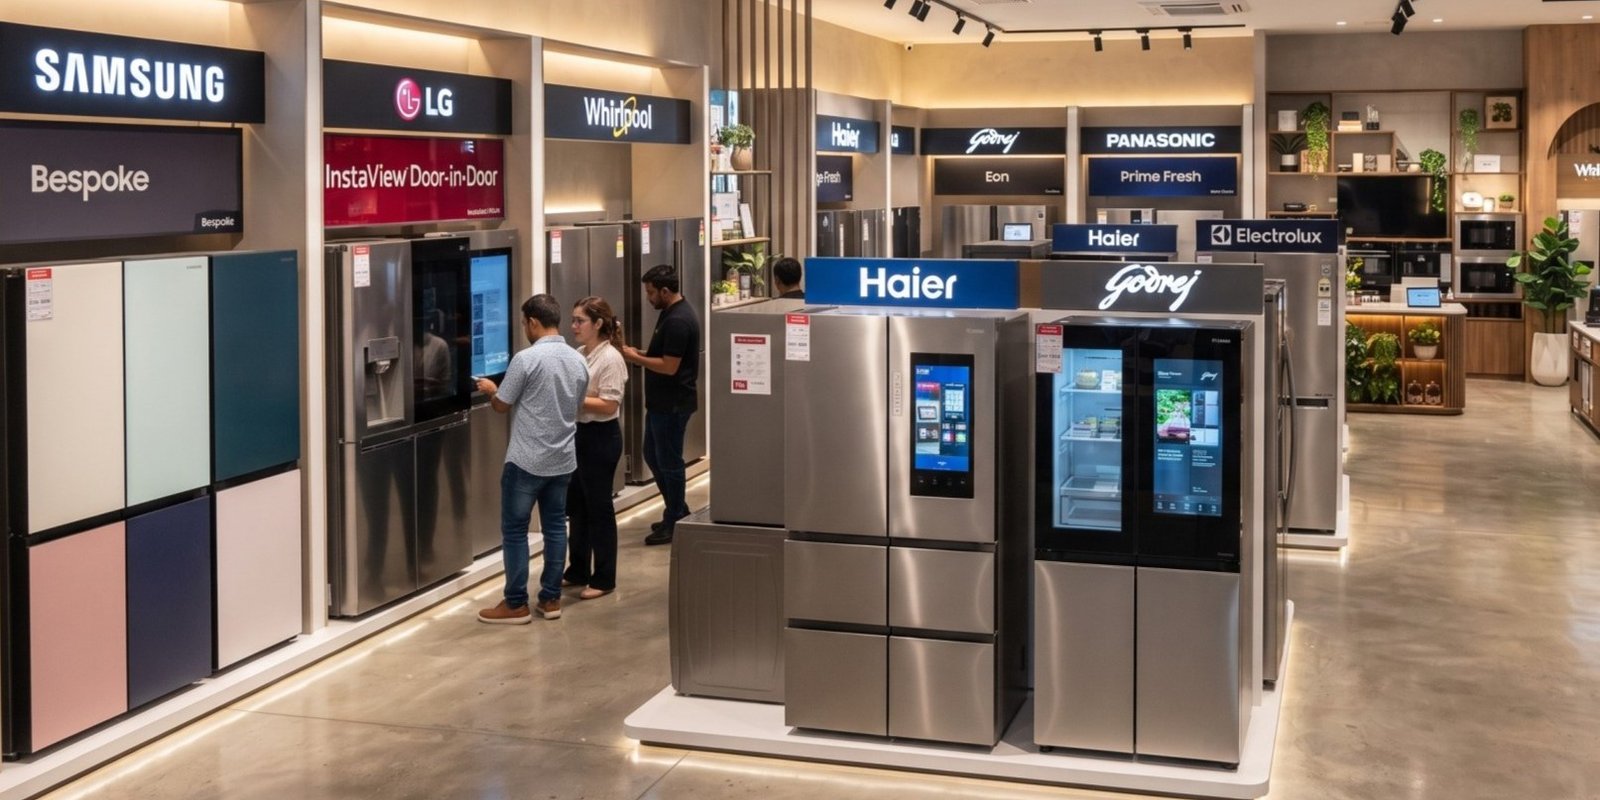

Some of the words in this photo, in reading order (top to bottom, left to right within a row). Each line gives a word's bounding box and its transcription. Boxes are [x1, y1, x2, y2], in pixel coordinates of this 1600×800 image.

[35, 48, 225, 103] SAMSUNG
[425, 86, 453, 117] LG
[583, 95, 652, 135] Whirlpool
[832, 122, 860, 149] Haier
[965, 127, 1021, 154] Godrej
[1106, 132, 1216, 149] PANASONIC
[31, 164, 150, 202] Bespoke
[985, 170, 1010, 183] Eon
[1120, 170, 1160, 183] Prime
[1163, 169, 1202, 183] Fresh
[1088, 229, 1140, 247] Haier
[1236, 227, 1323, 244] Electrolux
[859, 266, 958, 300] Haier
[1098, 264, 1202, 312] Godrej
